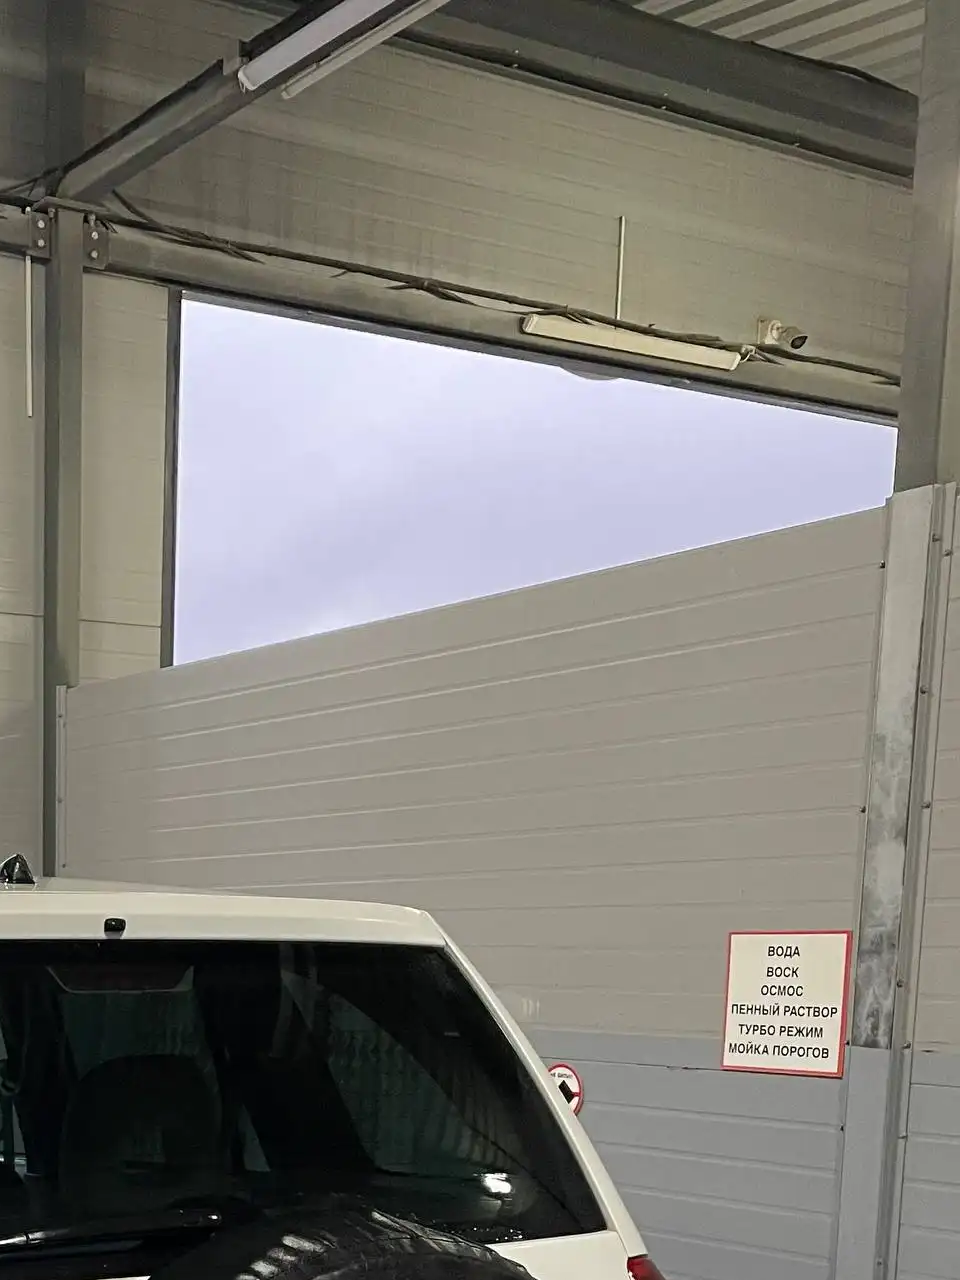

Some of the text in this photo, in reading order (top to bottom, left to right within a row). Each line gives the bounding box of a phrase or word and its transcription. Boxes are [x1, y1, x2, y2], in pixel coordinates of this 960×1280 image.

[767, 945, 801, 958] ВОДА
[766, 966, 799, 978] ВОСК
[760, 985, 804, 997] ОСМОС
[731, 1003, 838, 1018] ПЕННЫЙ РАСТВОР
[738, 1023, 824, 1038] ТУРБО РЕЖИМ
[728, 1041, 829, 1059] МОЙКА ПОРОГОВ
